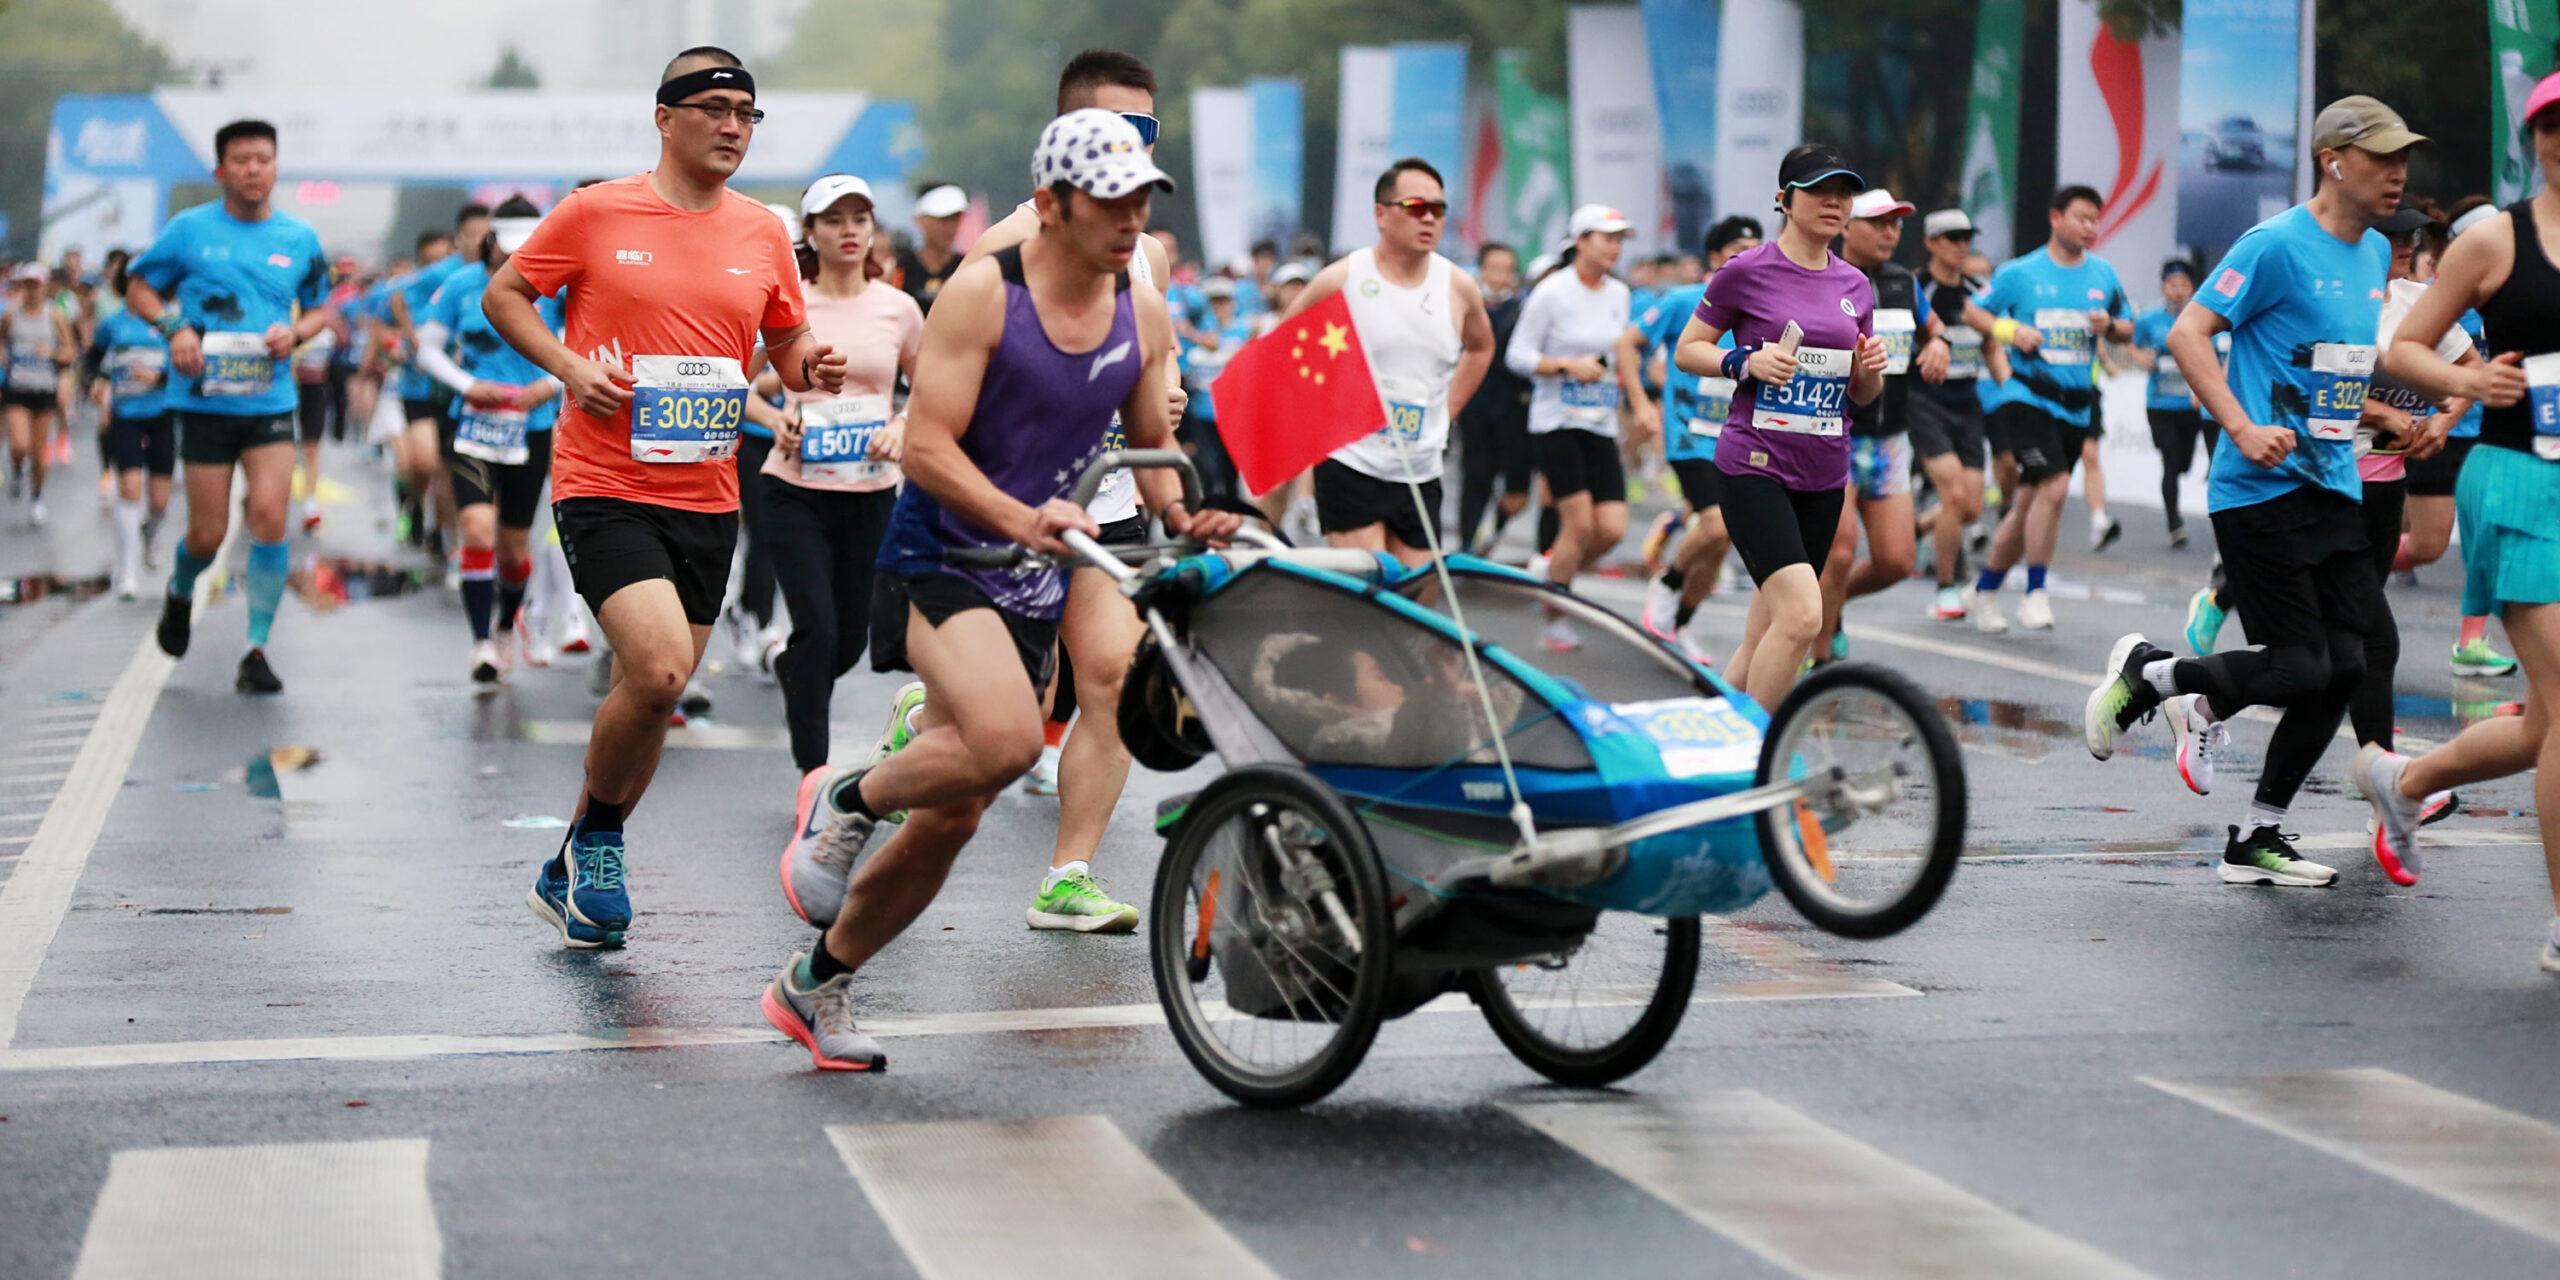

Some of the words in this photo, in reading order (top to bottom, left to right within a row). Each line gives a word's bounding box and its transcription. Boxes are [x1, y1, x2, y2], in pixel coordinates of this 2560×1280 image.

[1763, 385, 1773, 401] E
[1778, 380, 1846, 409] 51427
[2316, 389, 2328, 406] E
[640, 407, 652, 426] E
[657, 396, 741, 429] 30329
[2543, 403, 2556, 424] E
[808, 438, 819, 456] E
[822, 425, 884, 456] 5072
